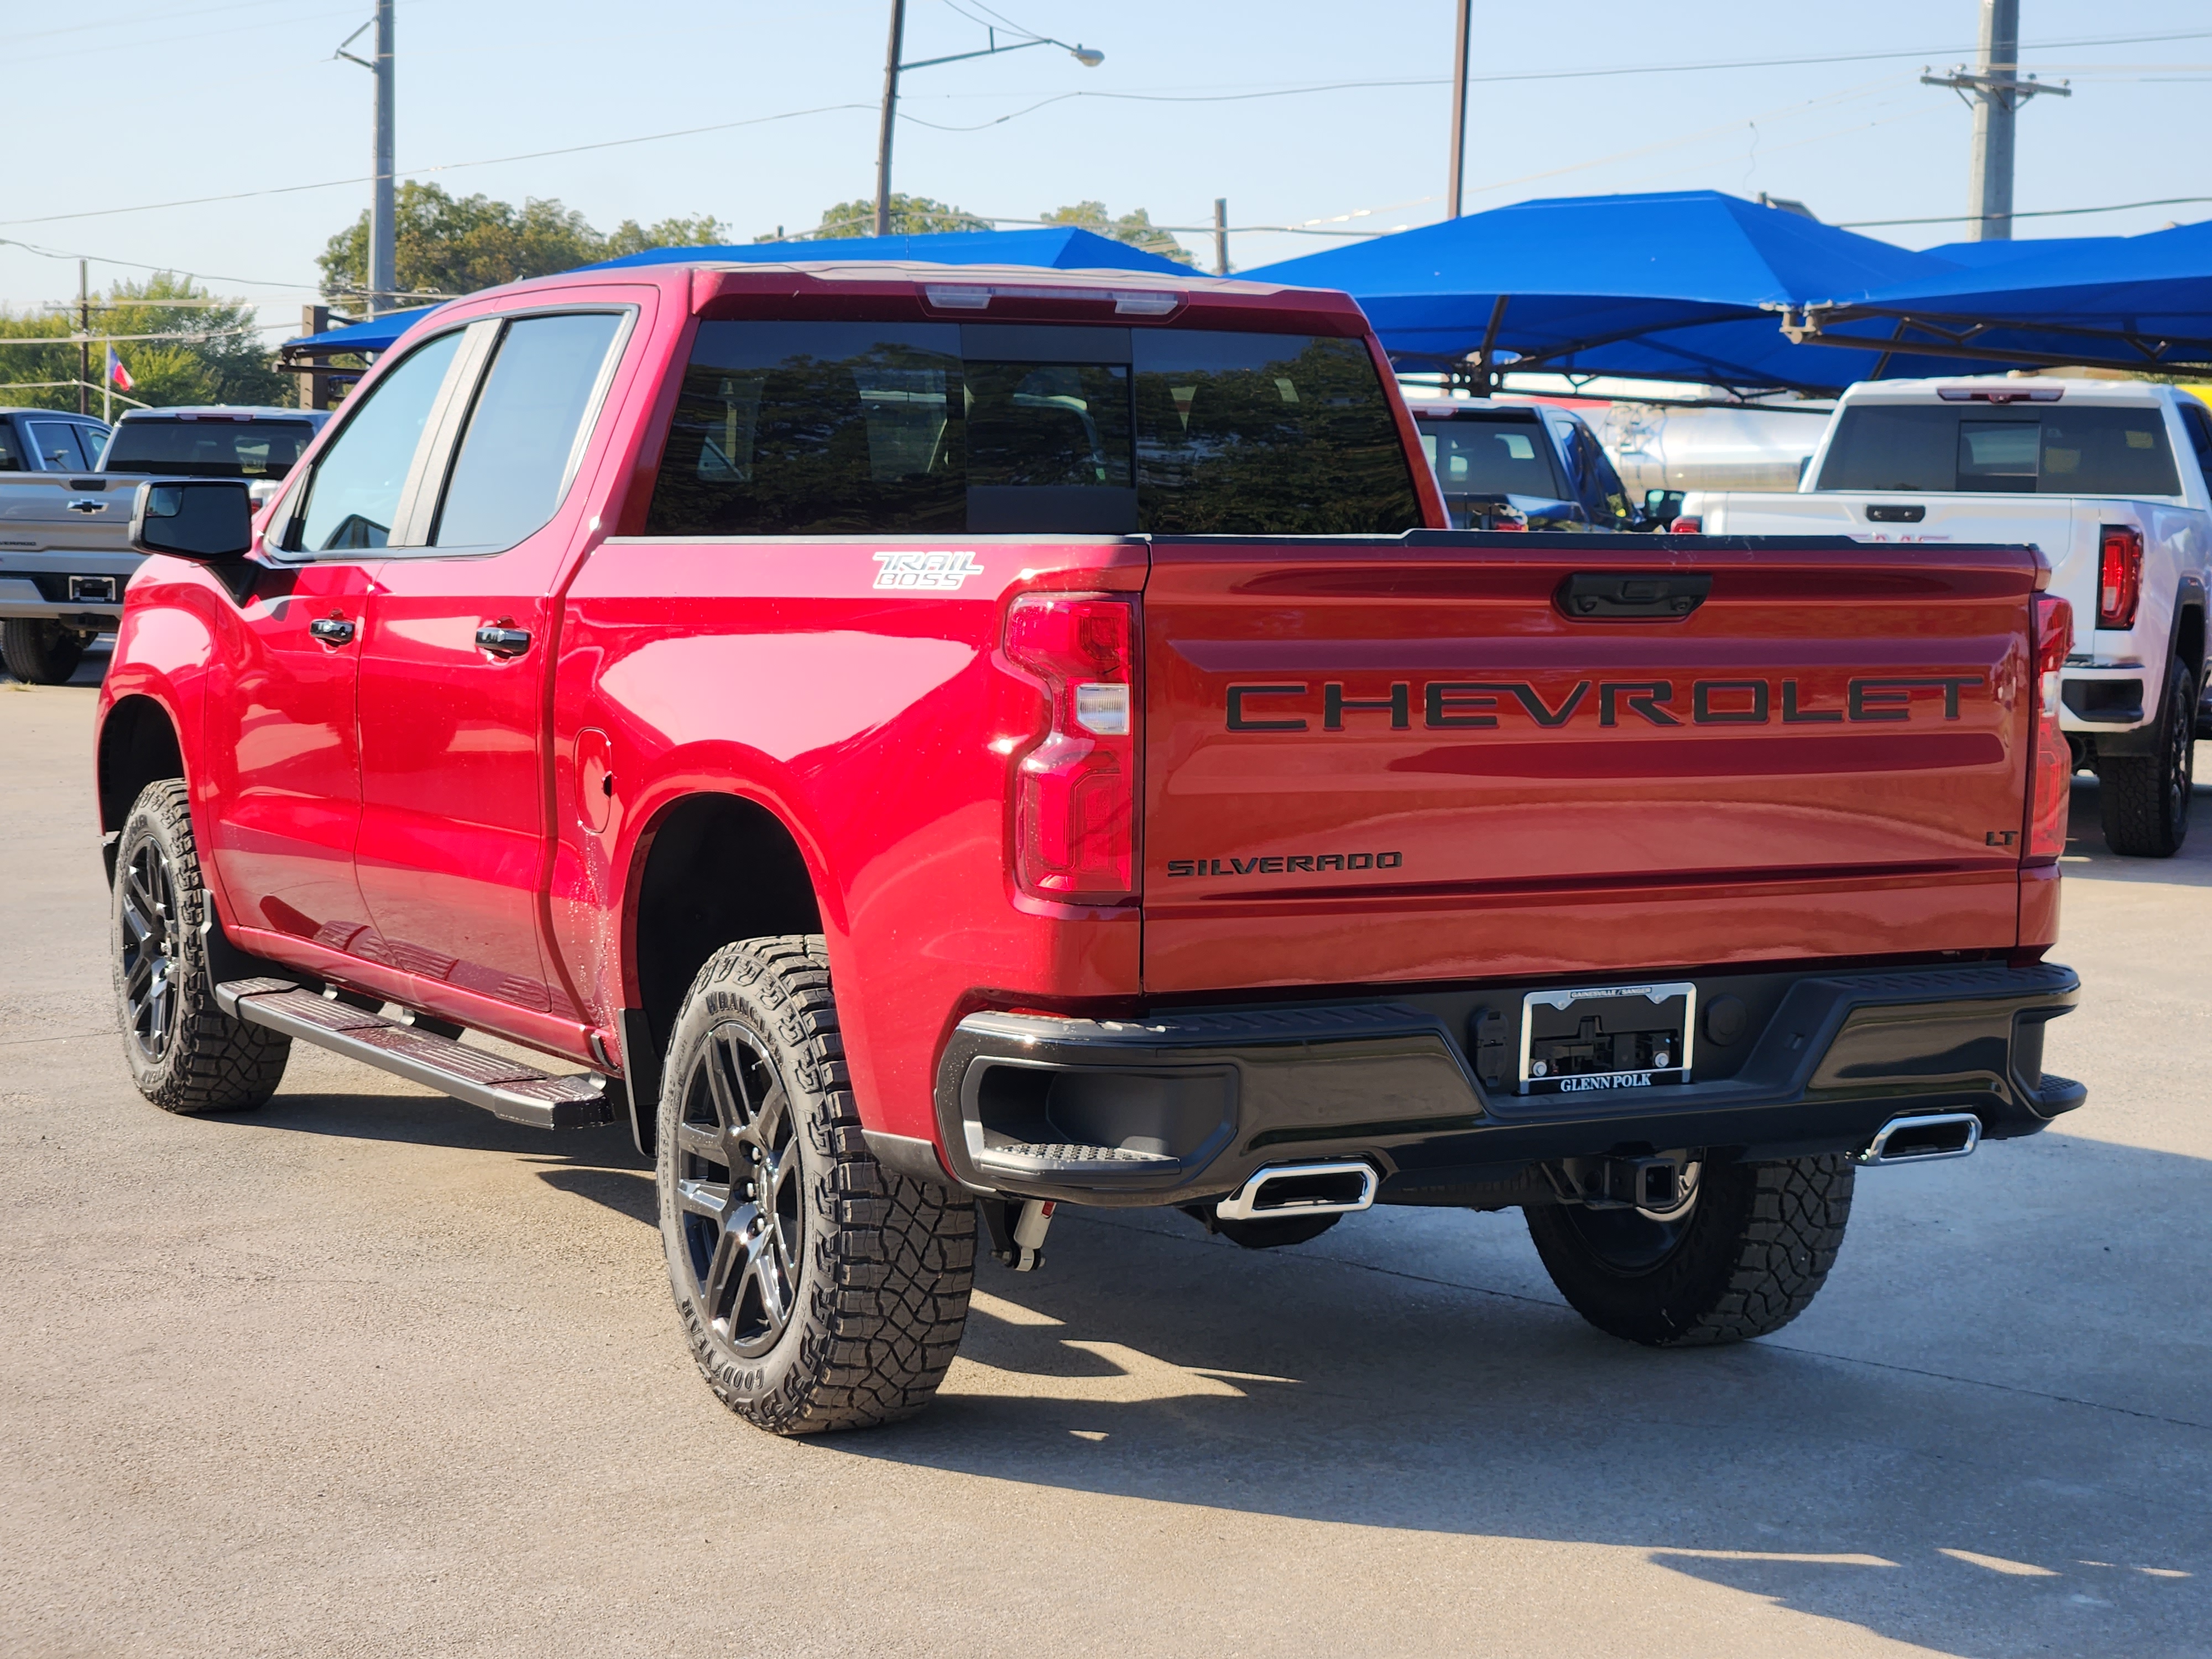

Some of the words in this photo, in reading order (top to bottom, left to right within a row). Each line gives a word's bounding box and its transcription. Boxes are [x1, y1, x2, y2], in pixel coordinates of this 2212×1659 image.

[873, 552, 983, 572] TRAIL
[875, 572, 966, 588] BOSS
[1226, 675, 1984, 730] CHEVROLET
[1986, 831, 2018, 846] LT
[1167, 852, 1403, 877] SILVERADO
[1561, 1076, 1611, 1092] GLENN
[1613, 1074, 1652, 1088] POLK
[681, 1296, 765, 1392] GOODYEAR
